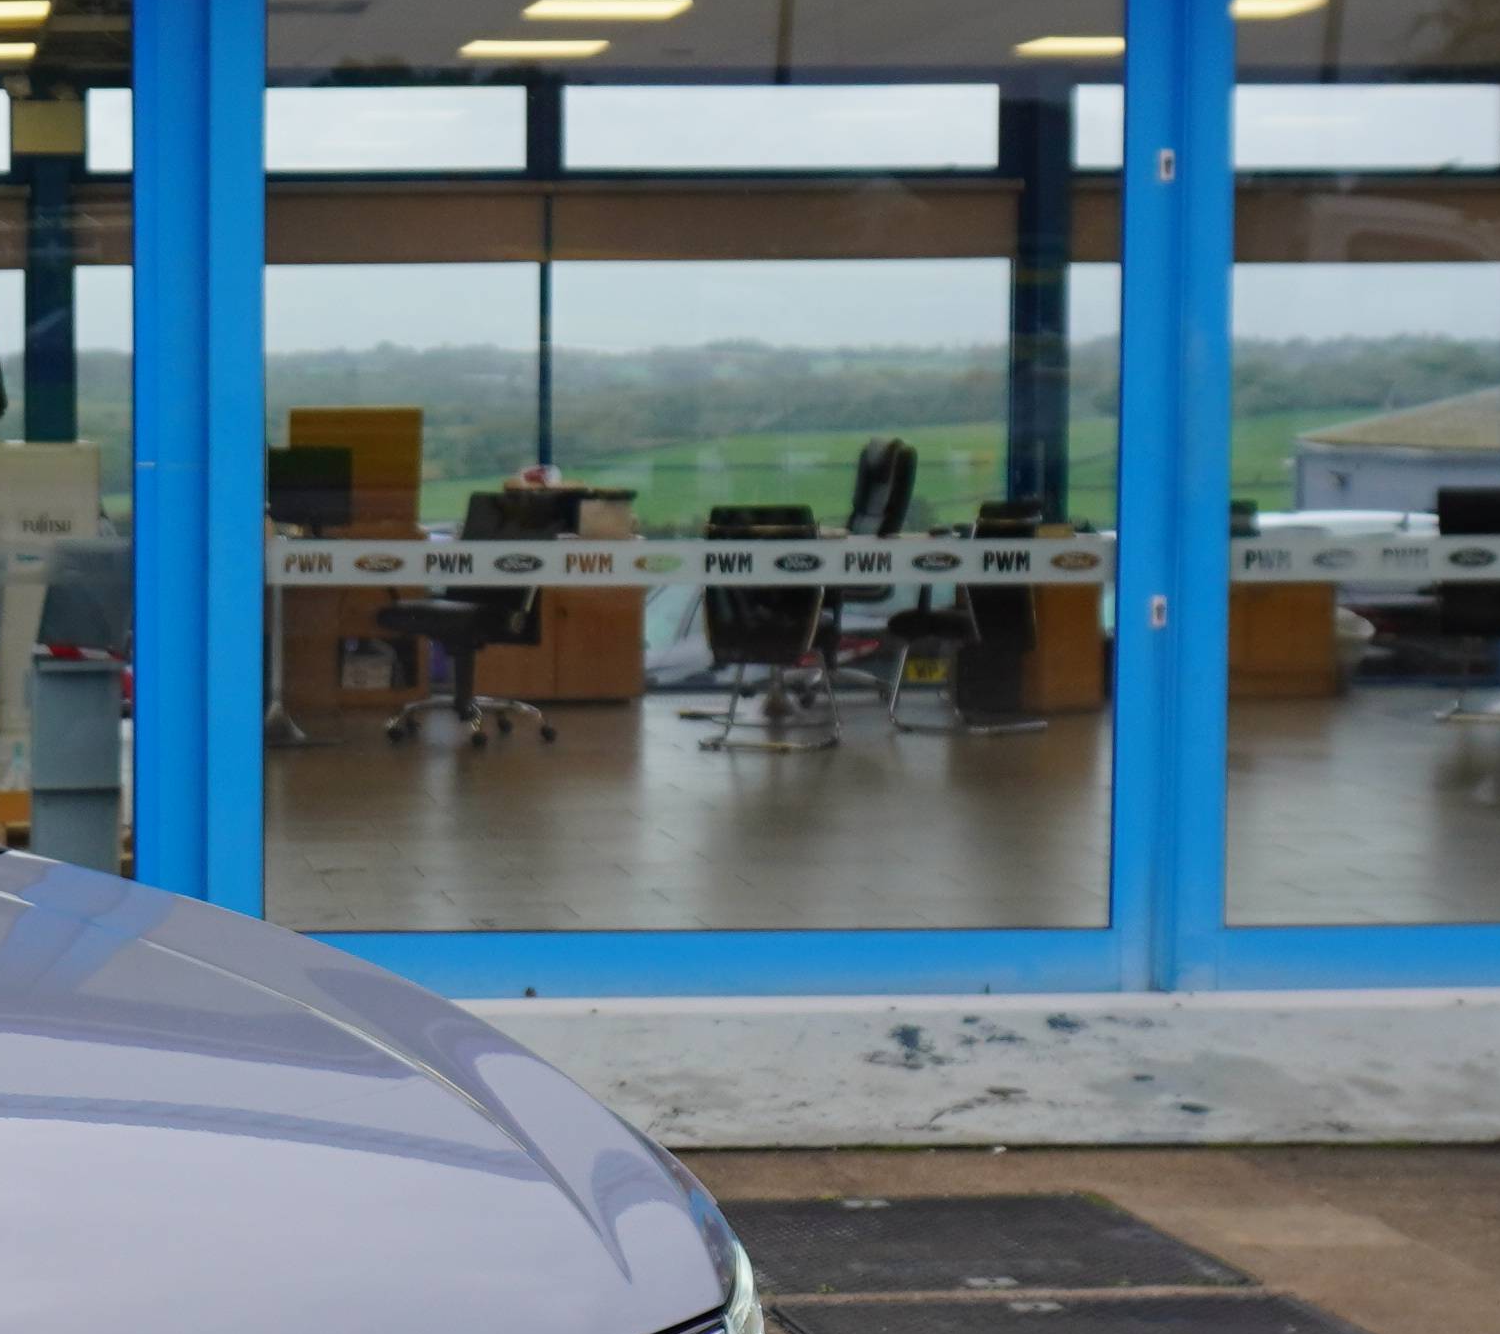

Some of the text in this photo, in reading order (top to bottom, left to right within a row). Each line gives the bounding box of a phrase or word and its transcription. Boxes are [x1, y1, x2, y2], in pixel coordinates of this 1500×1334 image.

[284, 553, 334, 574] PWM
[425, 552, 474, 574] PWM
[566, 553, 614, 574] PWM
[705, 552, 753, 574] PWM
[844, 551, 893, 573] PWM
[983, 550, 1031, 572] PWM
